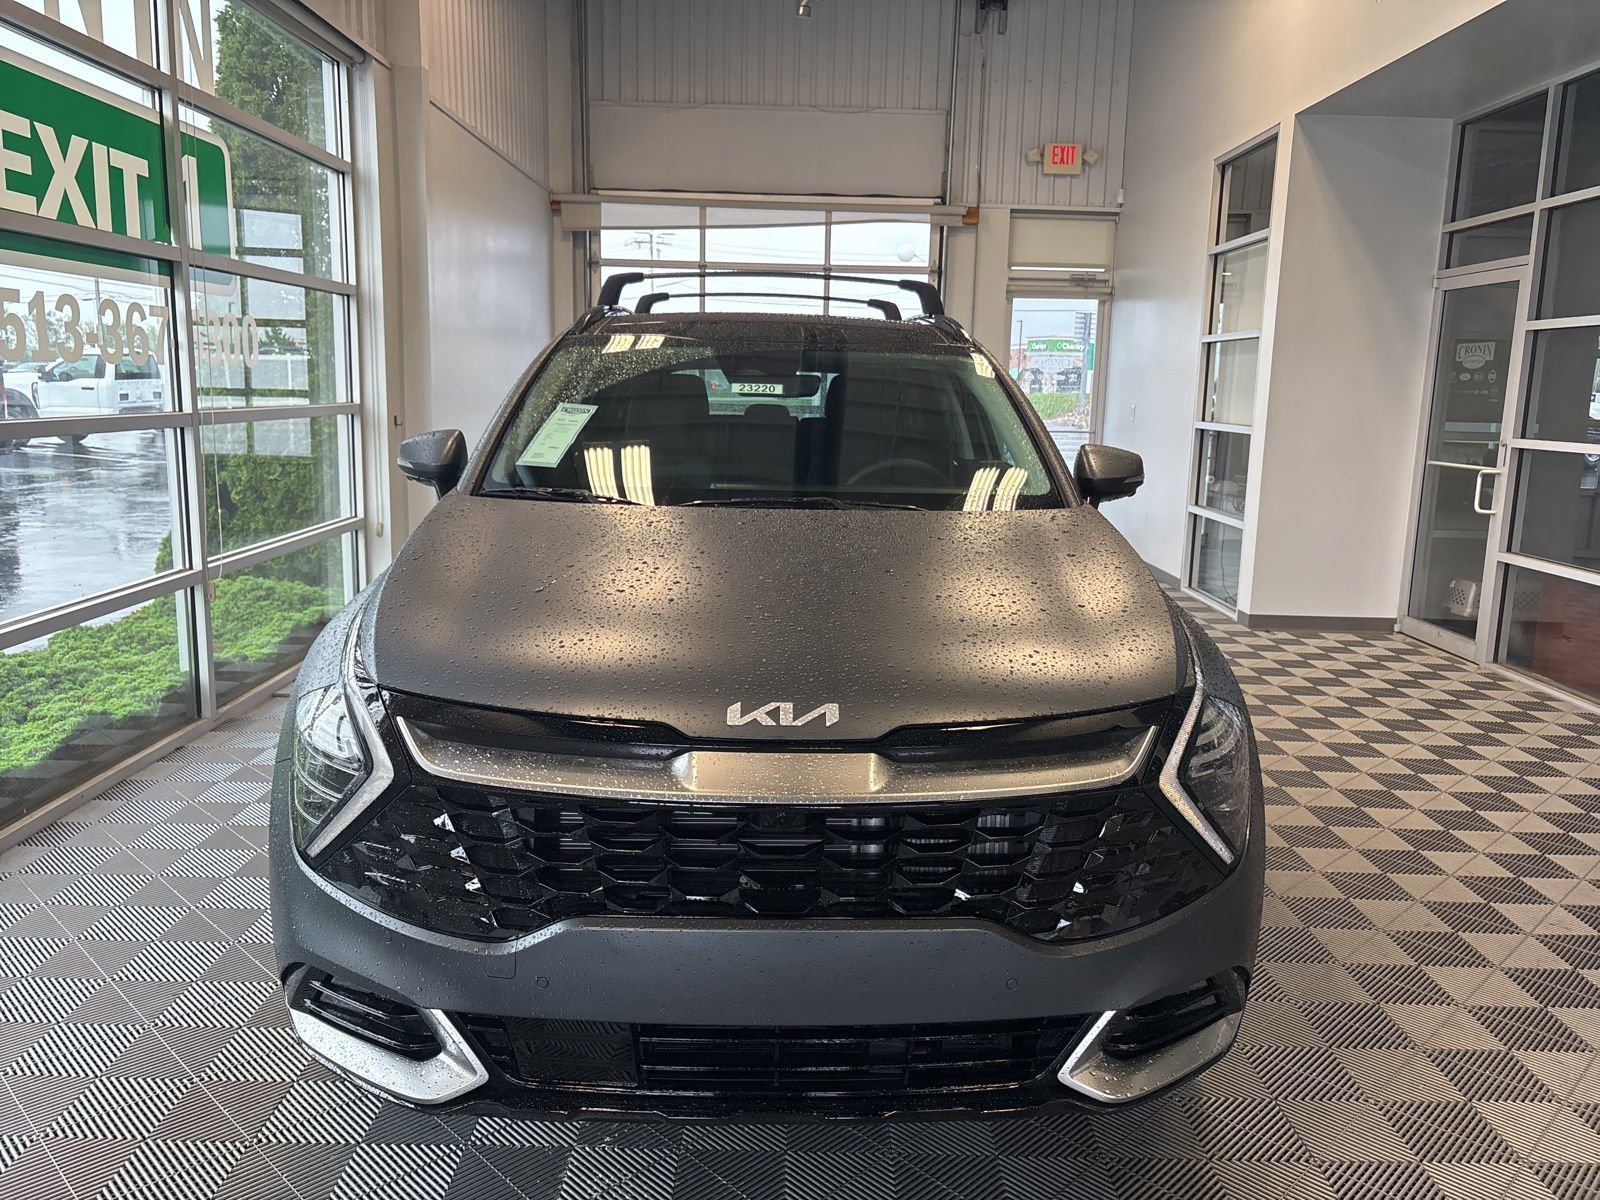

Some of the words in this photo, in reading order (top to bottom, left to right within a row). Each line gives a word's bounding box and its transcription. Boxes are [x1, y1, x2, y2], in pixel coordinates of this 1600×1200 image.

[1052, 145, 1077, 165] EXIT
[0, 110, 149, 239] EXIT
[738, 383, 776, 394] 23220
[726, 701, 840, 727] KIA
